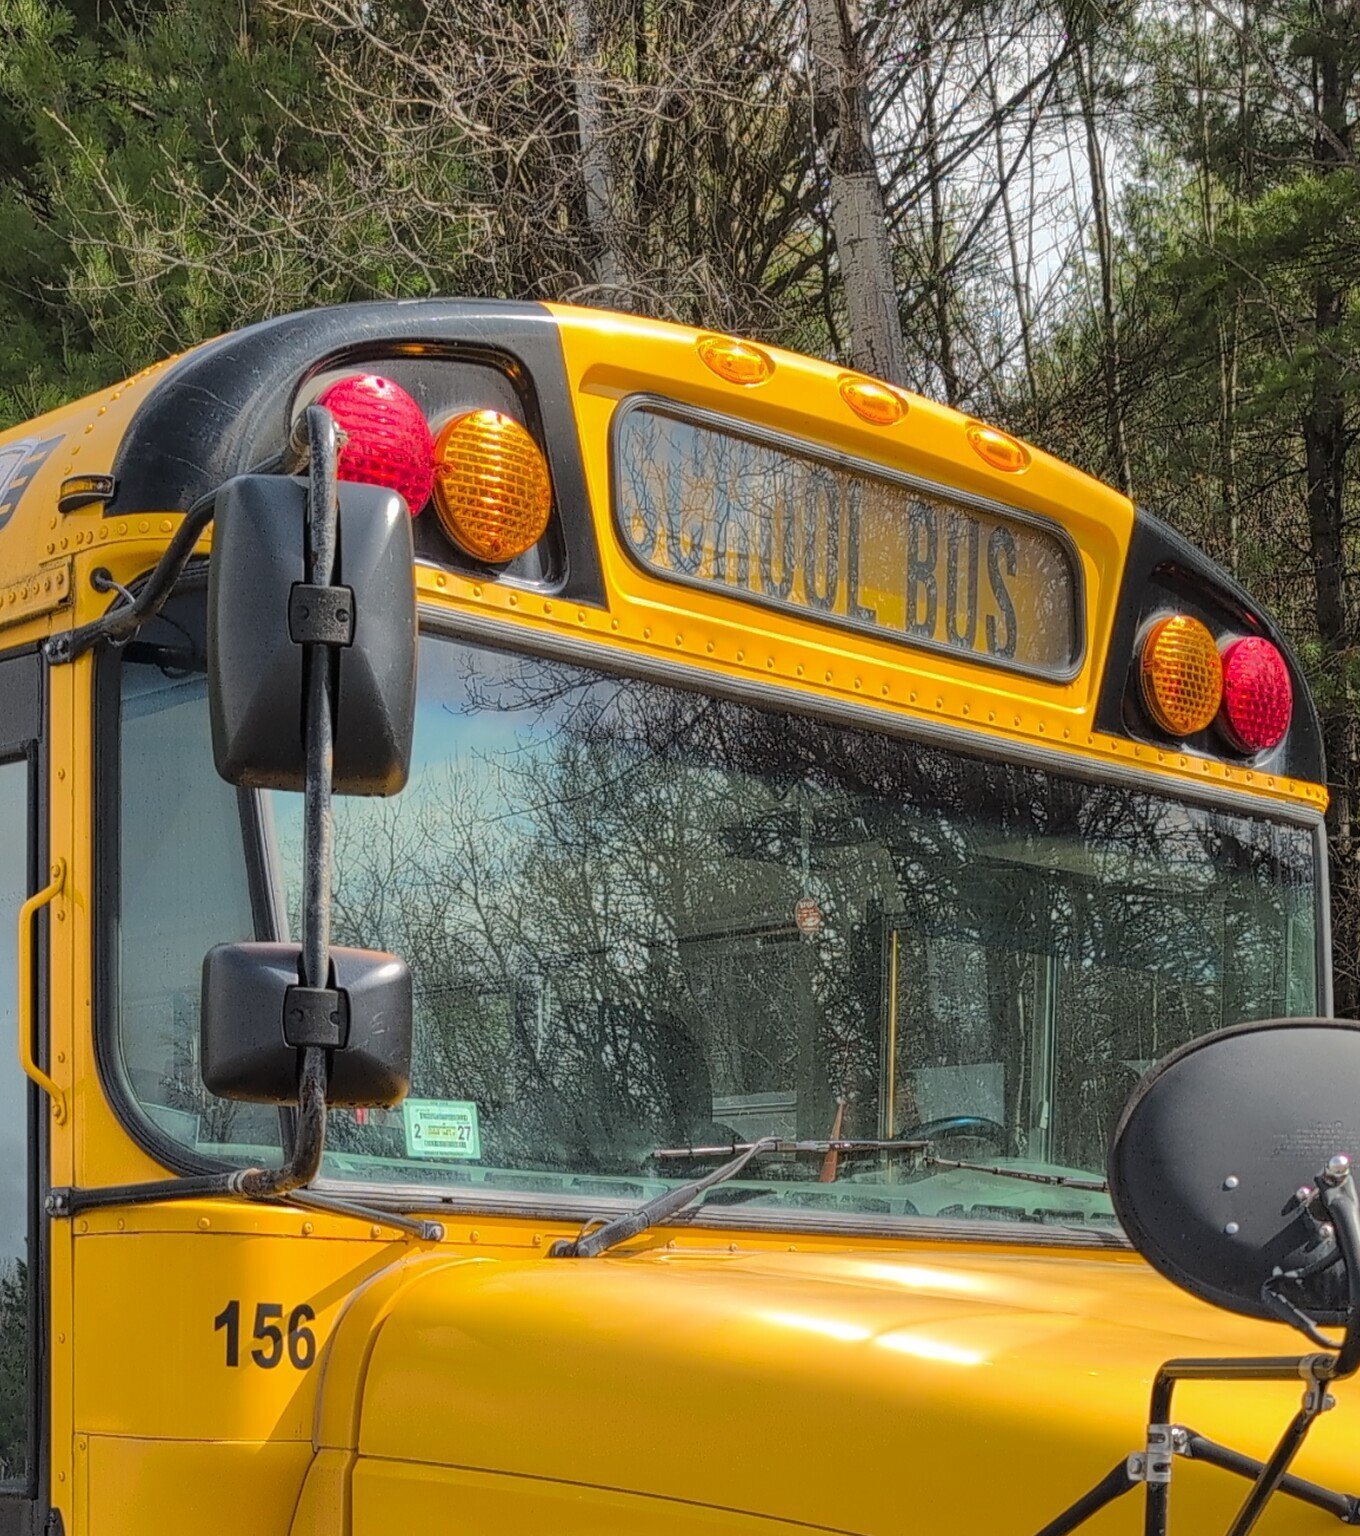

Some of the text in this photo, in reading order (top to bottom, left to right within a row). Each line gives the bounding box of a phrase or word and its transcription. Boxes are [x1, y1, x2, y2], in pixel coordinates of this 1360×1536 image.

[905, 498, 1018, 661] BUS
[414, 1123, 422, 1139] 2
[457, 1125, 471, 1142] 27
[214, 1300, 316, 1371] 156
